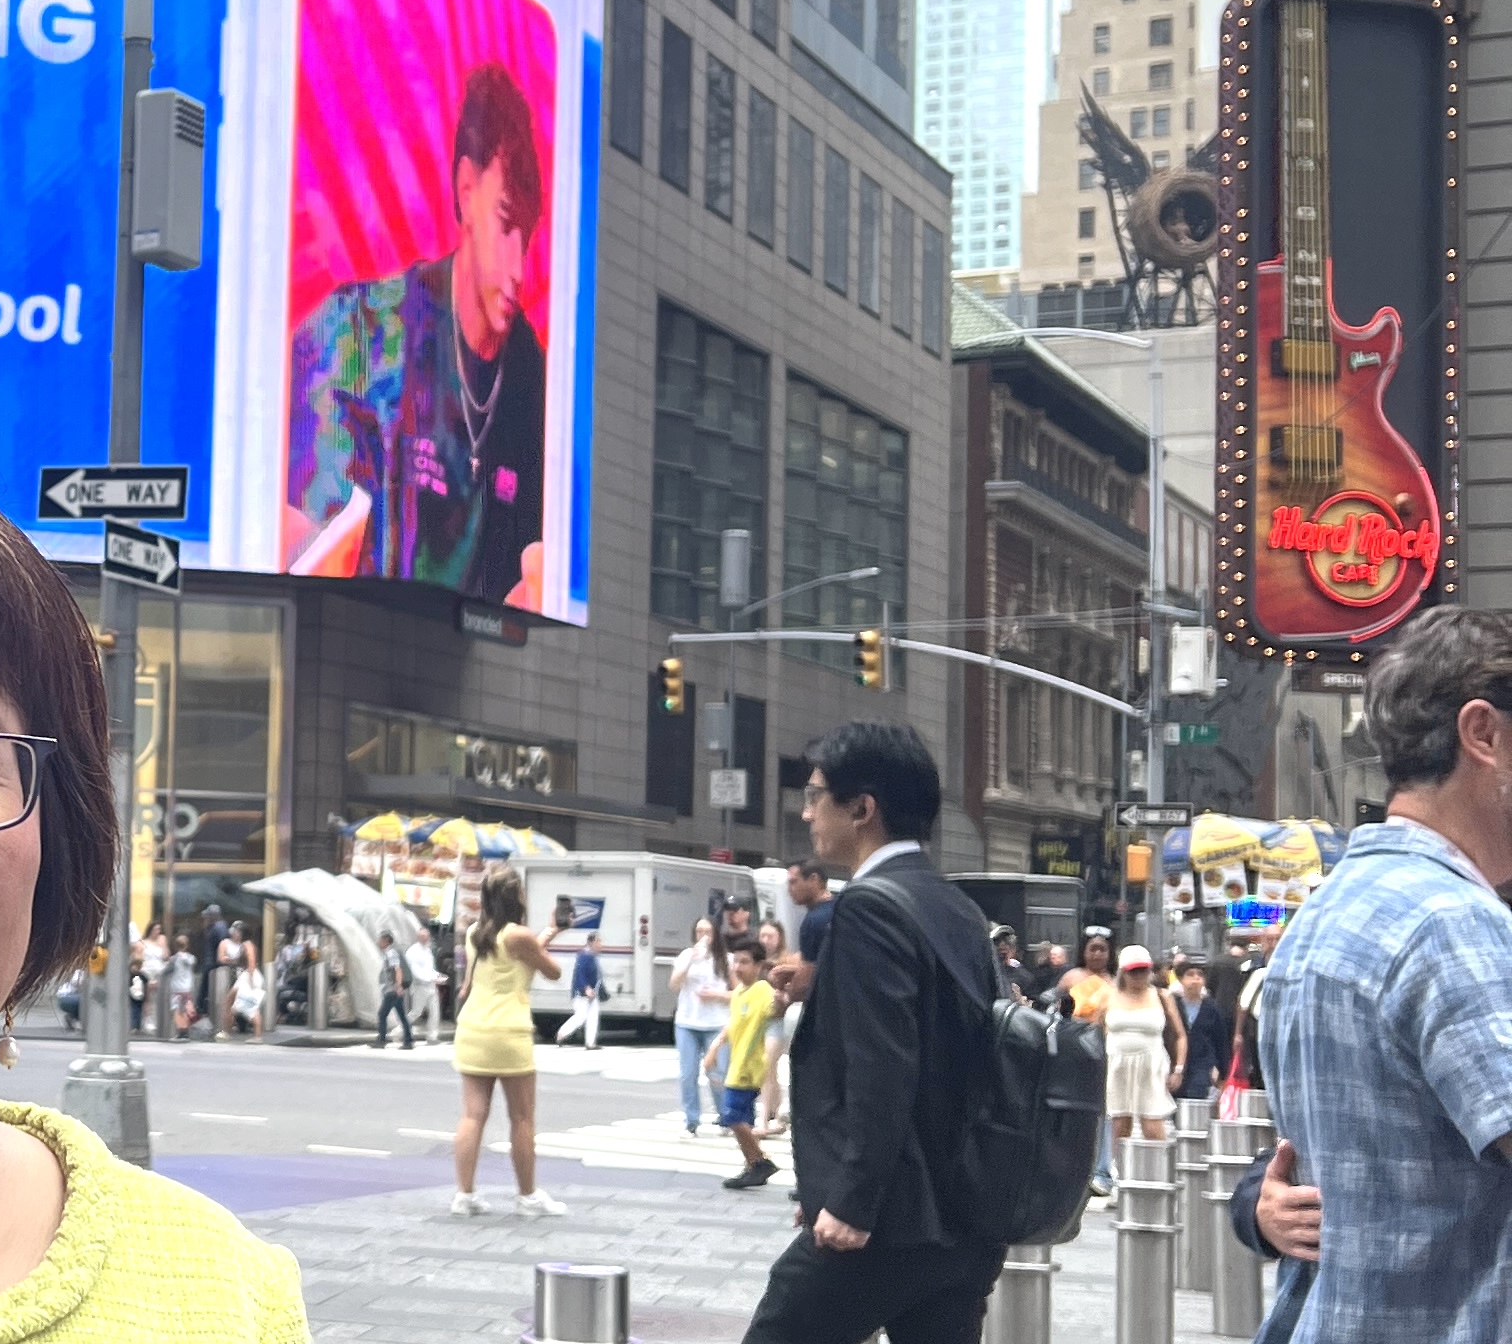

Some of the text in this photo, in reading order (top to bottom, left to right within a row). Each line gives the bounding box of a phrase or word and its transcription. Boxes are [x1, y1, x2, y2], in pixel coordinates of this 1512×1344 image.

[65, 482, 170, 504] ONE WAY
[1269, 505, 1438, 570] Hard Rock
[111, 538, 166, 567] ONE WAY
[1330, 562, 1379, 586] CAFE
